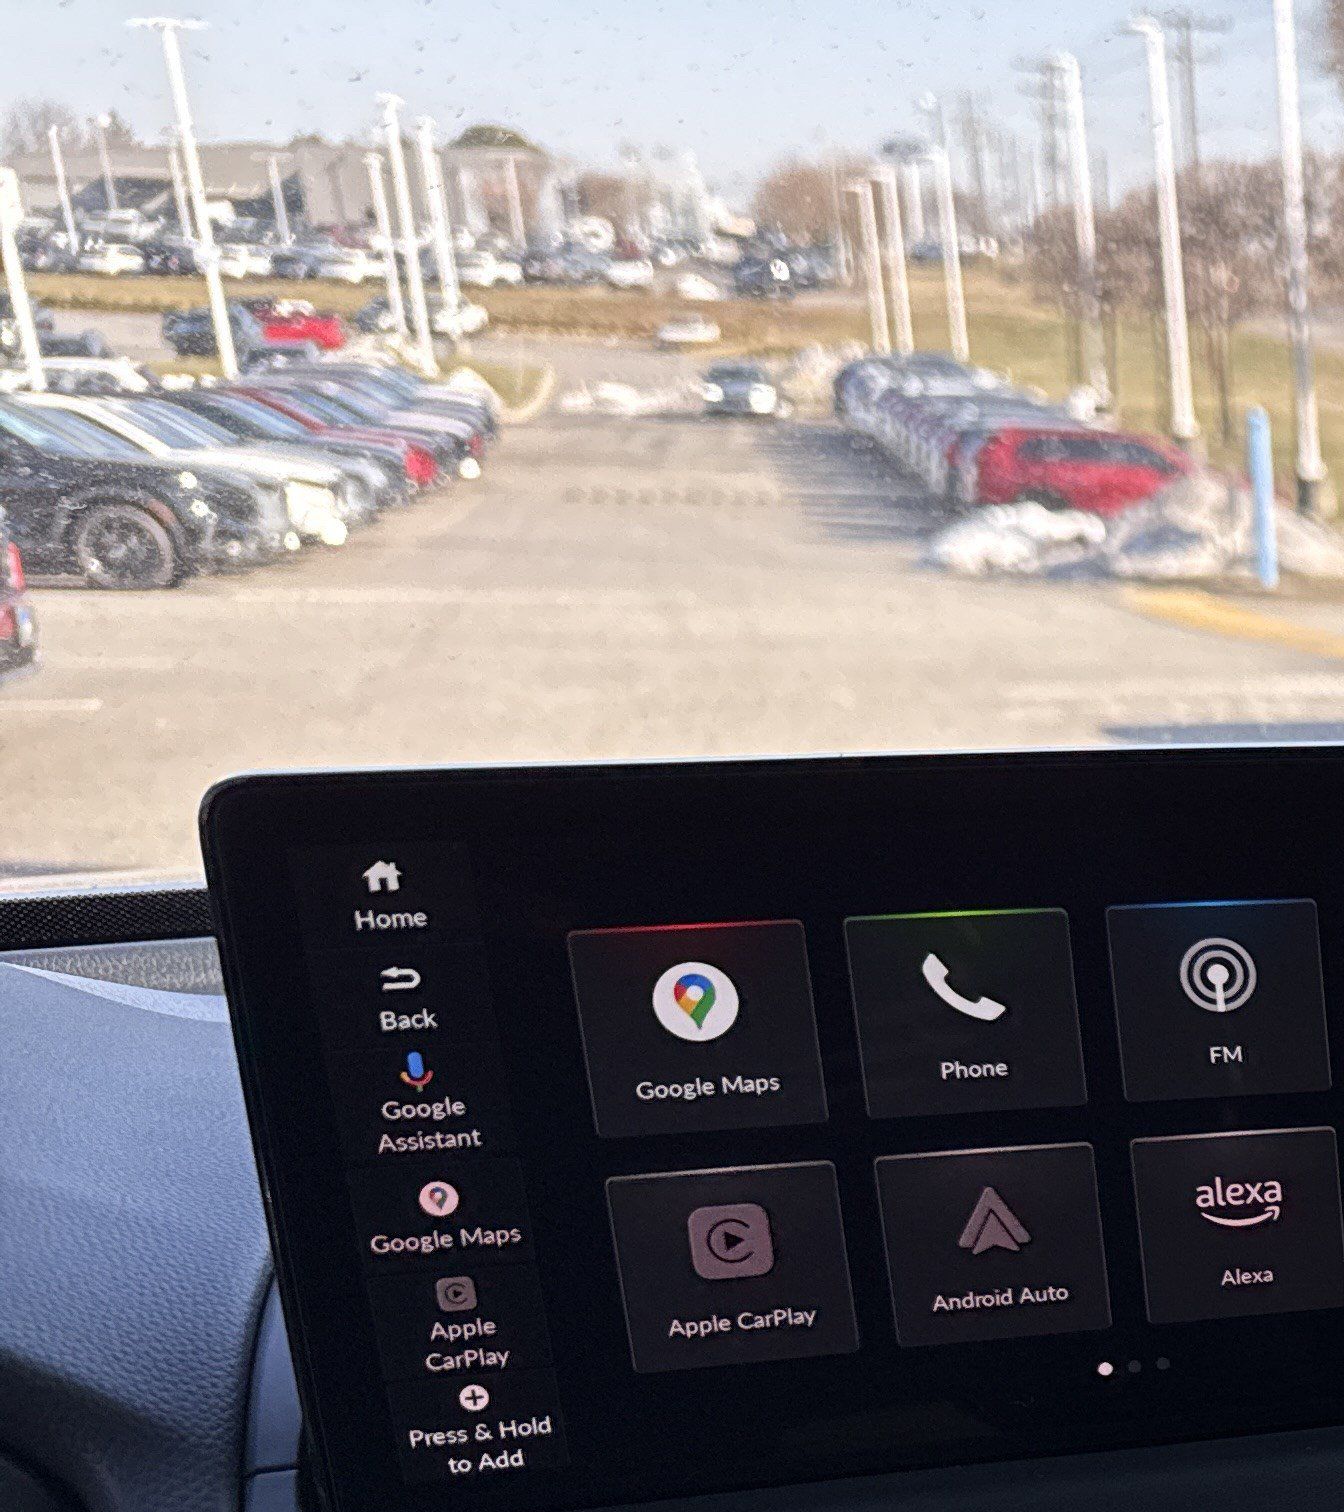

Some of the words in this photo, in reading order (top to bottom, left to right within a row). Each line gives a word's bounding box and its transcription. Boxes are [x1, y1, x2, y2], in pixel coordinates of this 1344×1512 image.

[355, 910, 427, 930] Home
[380, 1008, 437, 1030] Back
[1210, 1046, 1242, 1063] FM
[941, 1061, 1007, 1079] Phone
[636, 1077, 715, 1101] Google
[722, 1076, 779, 1095] Maps
[381, 1096, 465, 1120] Google
[379, 1129, 481, 1153] Assistant
[1195, 1176, 1283, 1209] alexa
[371, 1228, 453, 1254] Google
[460, 1226, 522, 1248] Maps
[1222, 1269, 1273, 1285] Alexa
[933, 1288, 1013, 1311] Android
[1020, 1287, 1068, 1304] Auto
[431, 1318, 496, 1342] Apple
[669, 1315, 731, 1338] Apple
[738, 1308, 815, 1329] CarPlay
[426, 1348, 510, 1371] CarPlay
[409, 1430, 467, 1448] Press
[475, 1424, 493, 1440] &
[499, 1416, 551, 1438] Hold
[448, 1458, 471, 1473] to
[479, 1449, 523, 1470] Add
